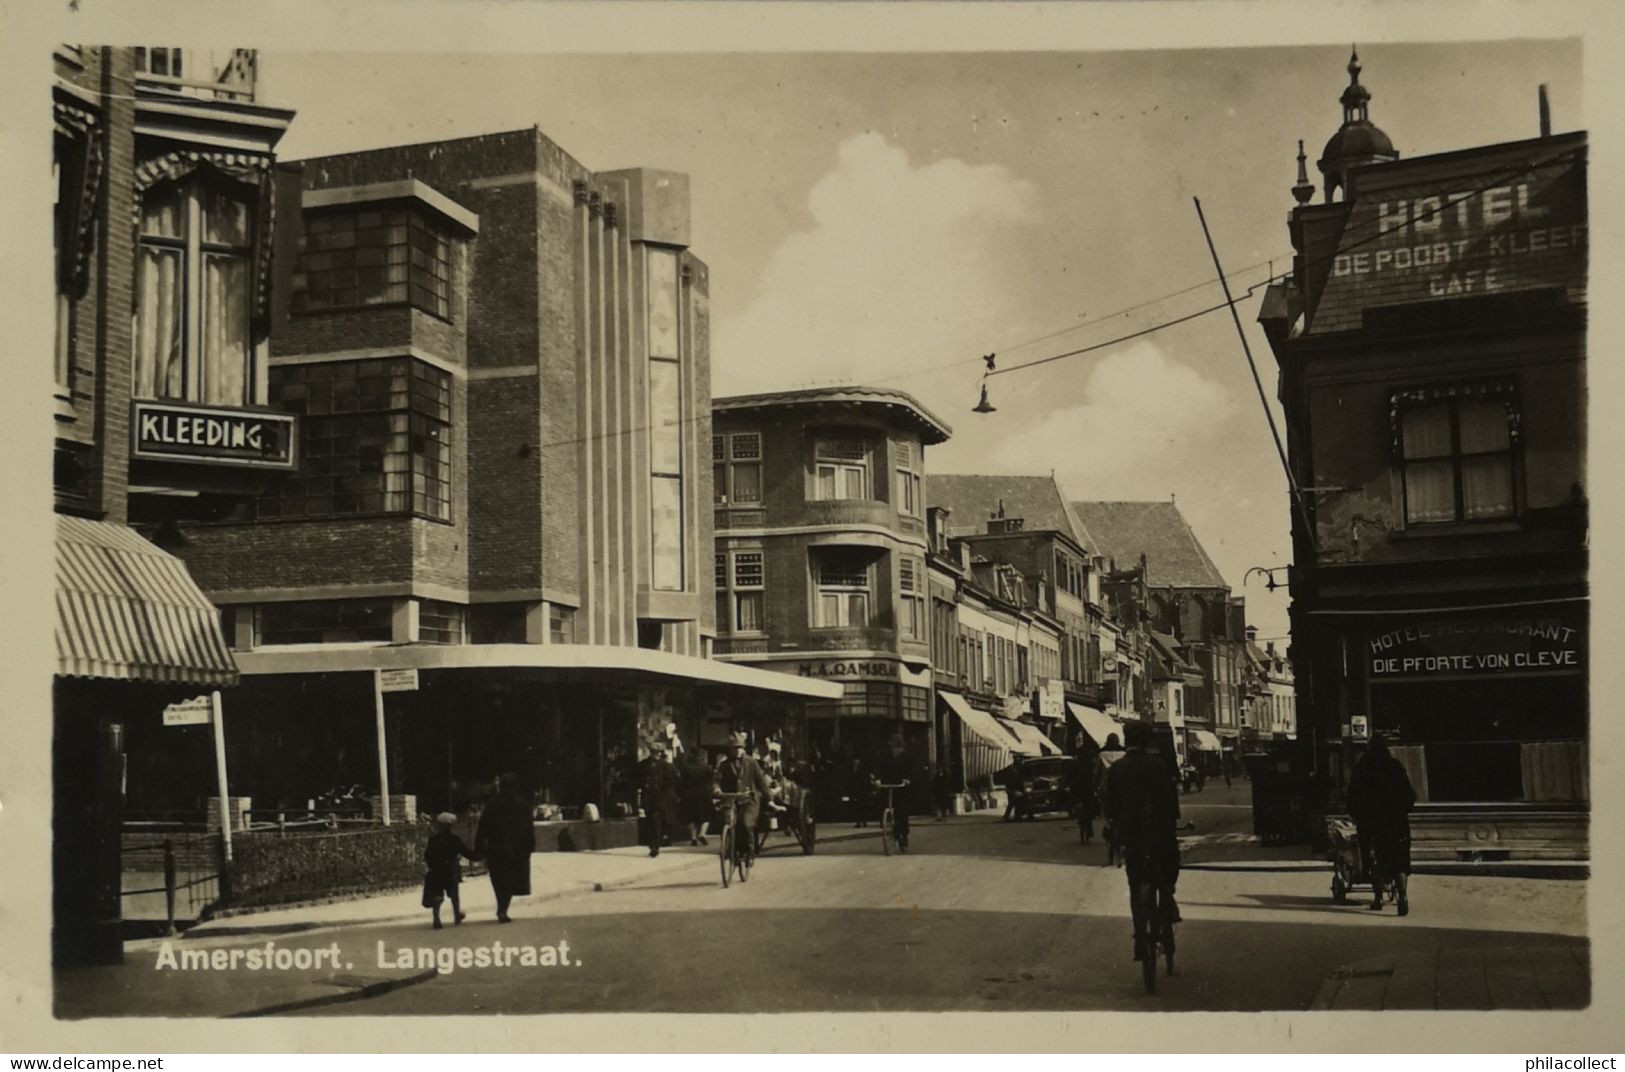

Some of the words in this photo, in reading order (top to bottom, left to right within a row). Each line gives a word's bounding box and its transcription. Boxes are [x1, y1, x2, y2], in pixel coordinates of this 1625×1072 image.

[1379, 184, 1548, 233] HOTEL
[1334, 253, 1370, 276] DE
[1376, 240, 1468, 271] POORT
[142, 414, 261, 449] KLEEDING
[1370, 624, 1431, 654] HOTEL
[1437, 621, 1577, 644] RESAURANT
[1373, 657, 1400, 674] DIE
[1403, 655, 1474, 673] PFORTE
[1476, 653, 1509, 669] VON
[1514, 649, 1578, 668] CLEVE
